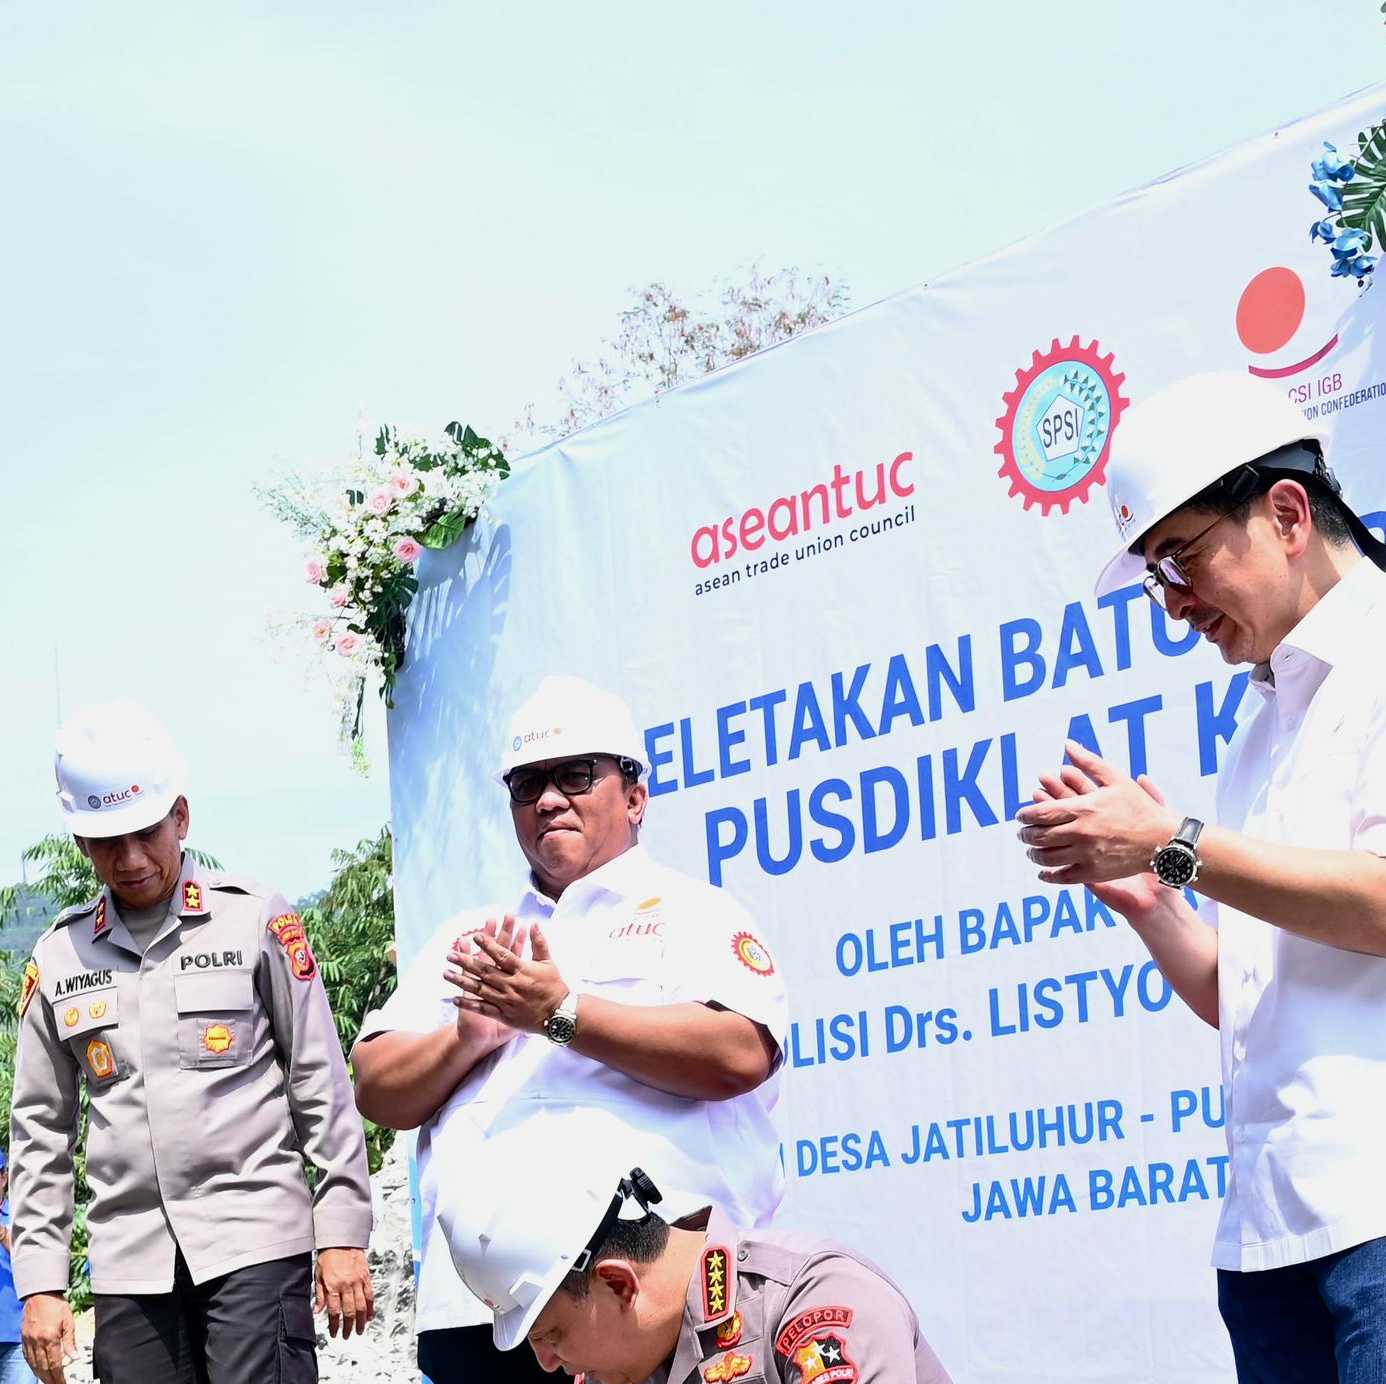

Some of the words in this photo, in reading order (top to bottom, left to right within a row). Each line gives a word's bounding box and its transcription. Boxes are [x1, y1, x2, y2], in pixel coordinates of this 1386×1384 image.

[1318, 373, 1343, 396] IGB
[1042, 407, 1079, 449] SPSI
[691, 451, 915, 569] aseantuc
[694, 569, 741, 596] asean
[746, 552, 790, 578] trade
[795, 533, 844, 561] union
[849, 504, 915, 542] council
[644, 635, 975, 798] ELETAKAN
[102, 790, 133, 805] atuc
[180, 950, 244, 971] POLRI
[835, 915, 945, 978] OLEH
[958, 884, 1116, 955] BAPAK
[55, 969, 112, 997] A.WIYAGUS
[784, 1010, 869, 1069] LISI
[884, 1004, 972, 1054] Drs.
[988, 960, 1173, 1037] LISTYO
[796, 1130, 891, 1178] DESA
[900, 1099, 1125, 1165] JATILUHUR
[1170, 1084, 1226, 1133] PU
[961, 1173, 1078, 1224] JAWA
[1088, 1155, 1230, 1211] BARAT
[782, 1309, 844, 1352] PELOPOR
